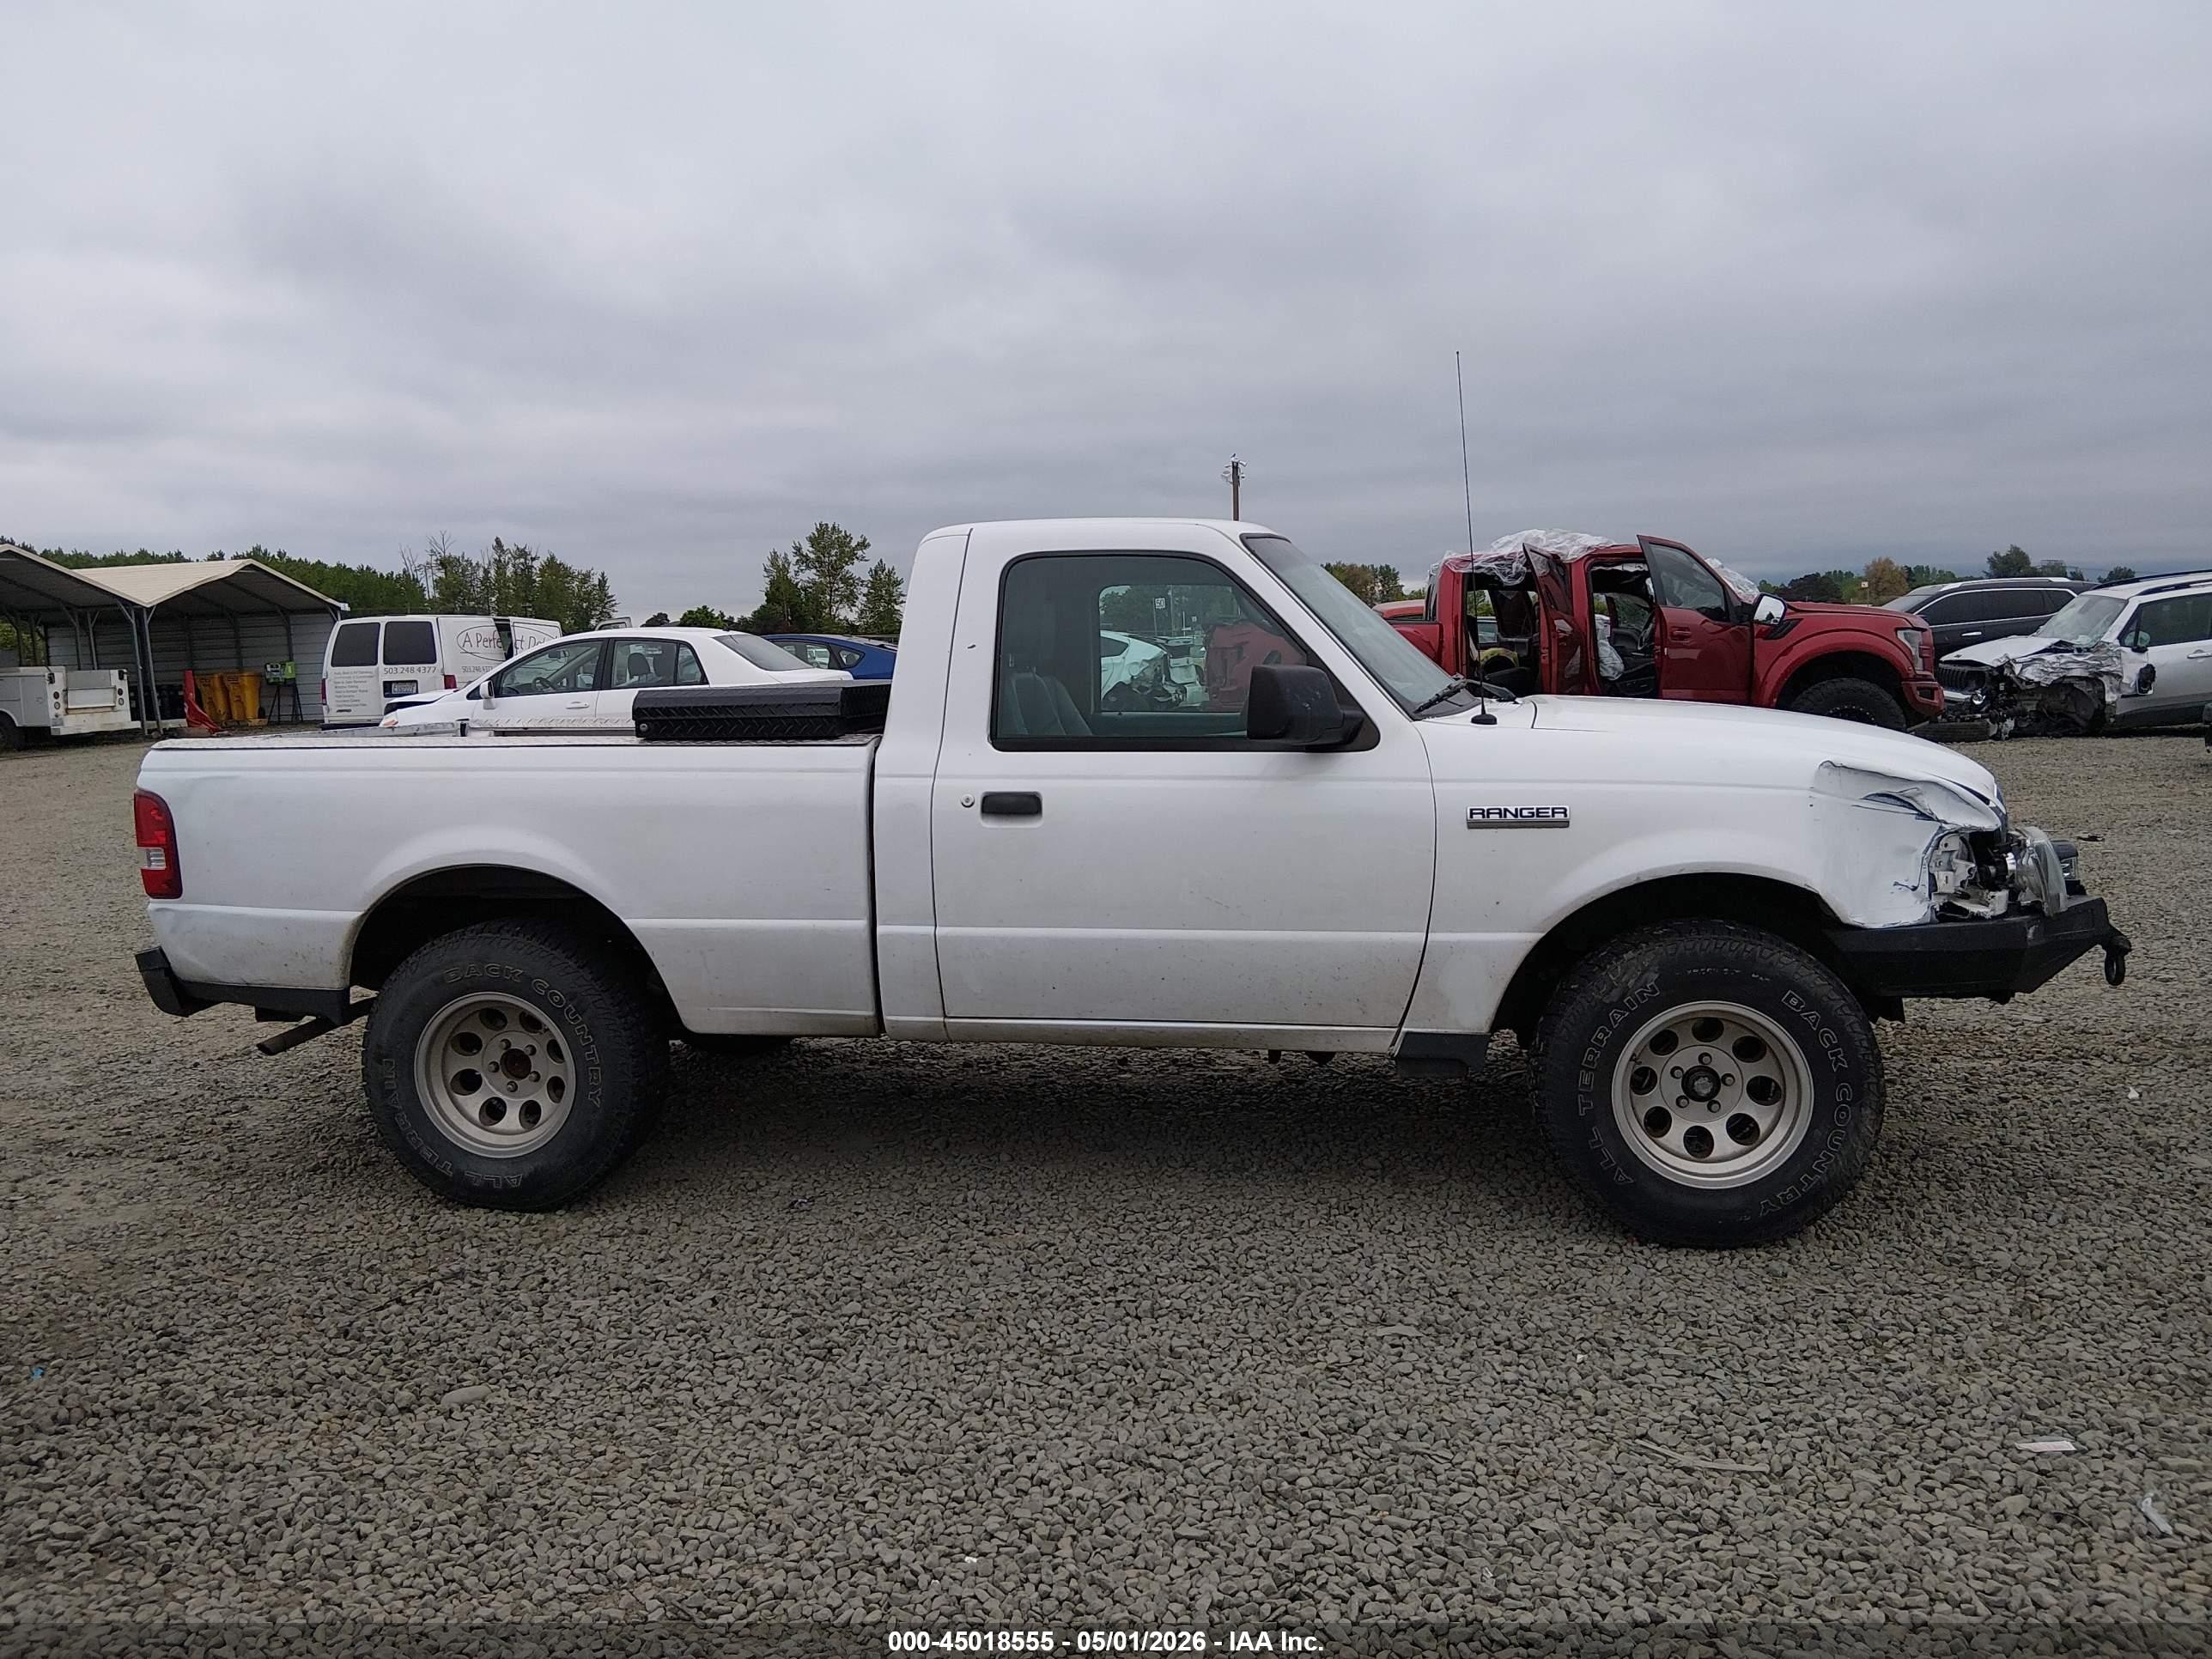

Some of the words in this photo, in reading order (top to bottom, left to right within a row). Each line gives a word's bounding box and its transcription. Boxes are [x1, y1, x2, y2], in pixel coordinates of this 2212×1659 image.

[462, 632, 473, 647] A
[1469, 807, 1568, 819] RANGER
[441, 962, 524, 984] BACK
[531, 977, 605, 1108] COUNTRY
[1577, 979, 1662, 1117] TERRAIN
[1781, 988, 1850, 1073] BACK
[382, 1058, 454, 1178] TERRAIN
[1588, 1126, 1635, 1187] ALL
[1759, 1082, 1854, 1217] COUNTRY
[464, 1171, 523, 1189] ALL
